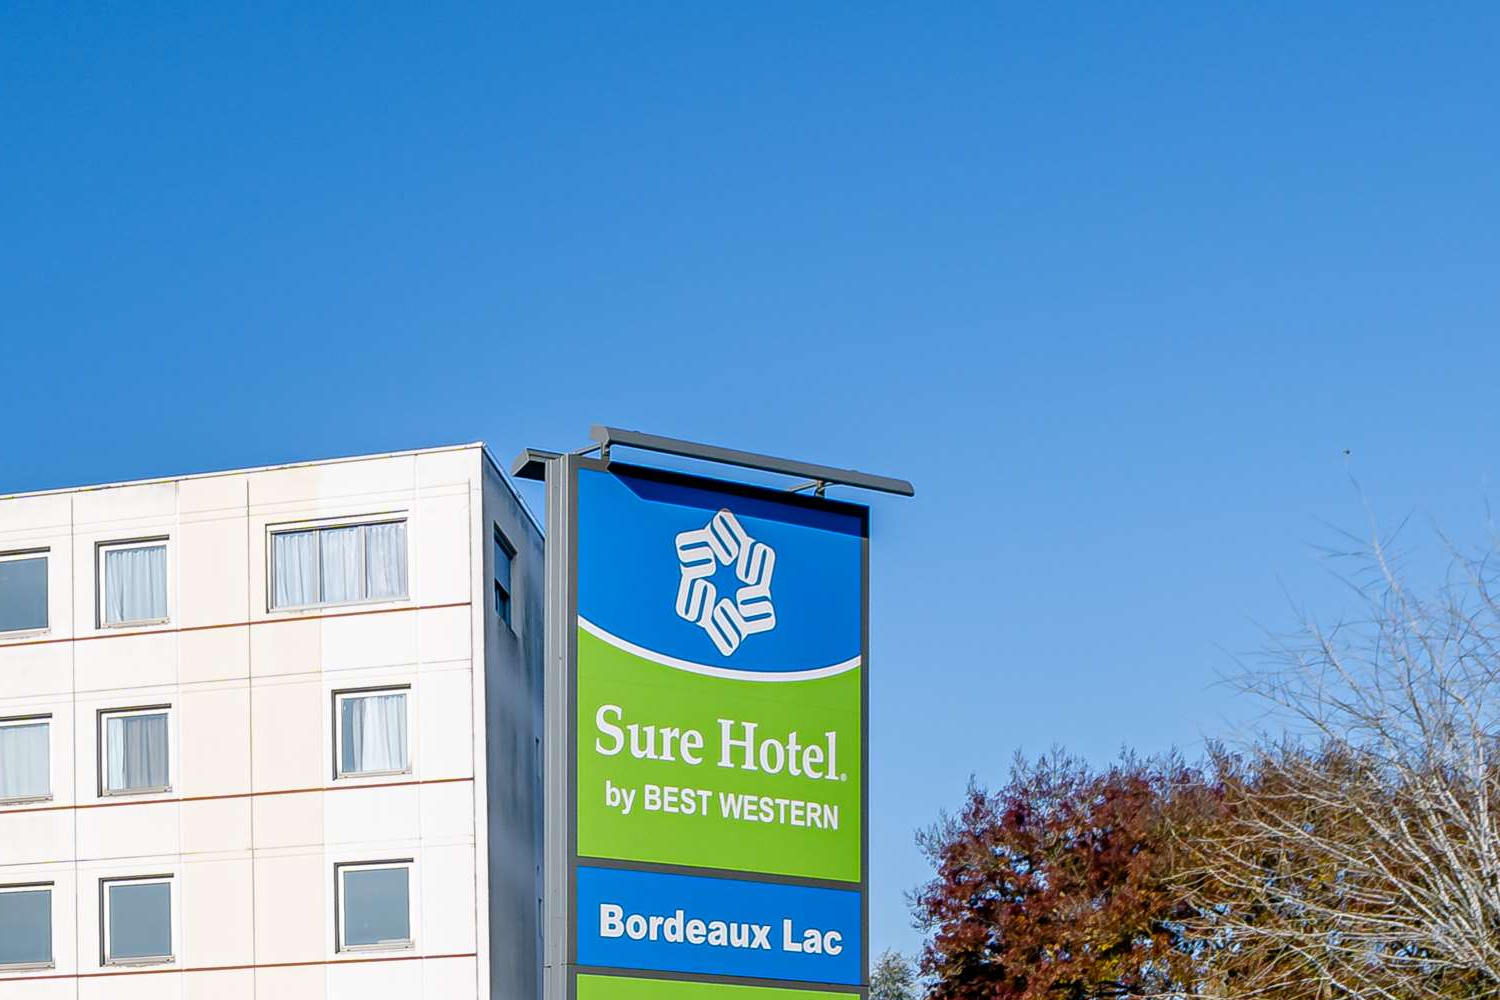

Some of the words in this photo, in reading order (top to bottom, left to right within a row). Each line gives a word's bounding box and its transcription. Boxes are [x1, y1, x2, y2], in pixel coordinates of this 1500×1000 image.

[595, 704, 704, 765] Sure
[717, 719, 840, 781] Hotel
[605, 780, 636, 815] by
[644, 784, 712, 816] BEST
[719, 792, 838, 830] WESTERN
[600, 903, 771, 949] Bordeaux
[783, 919, 843, 955] Lac
